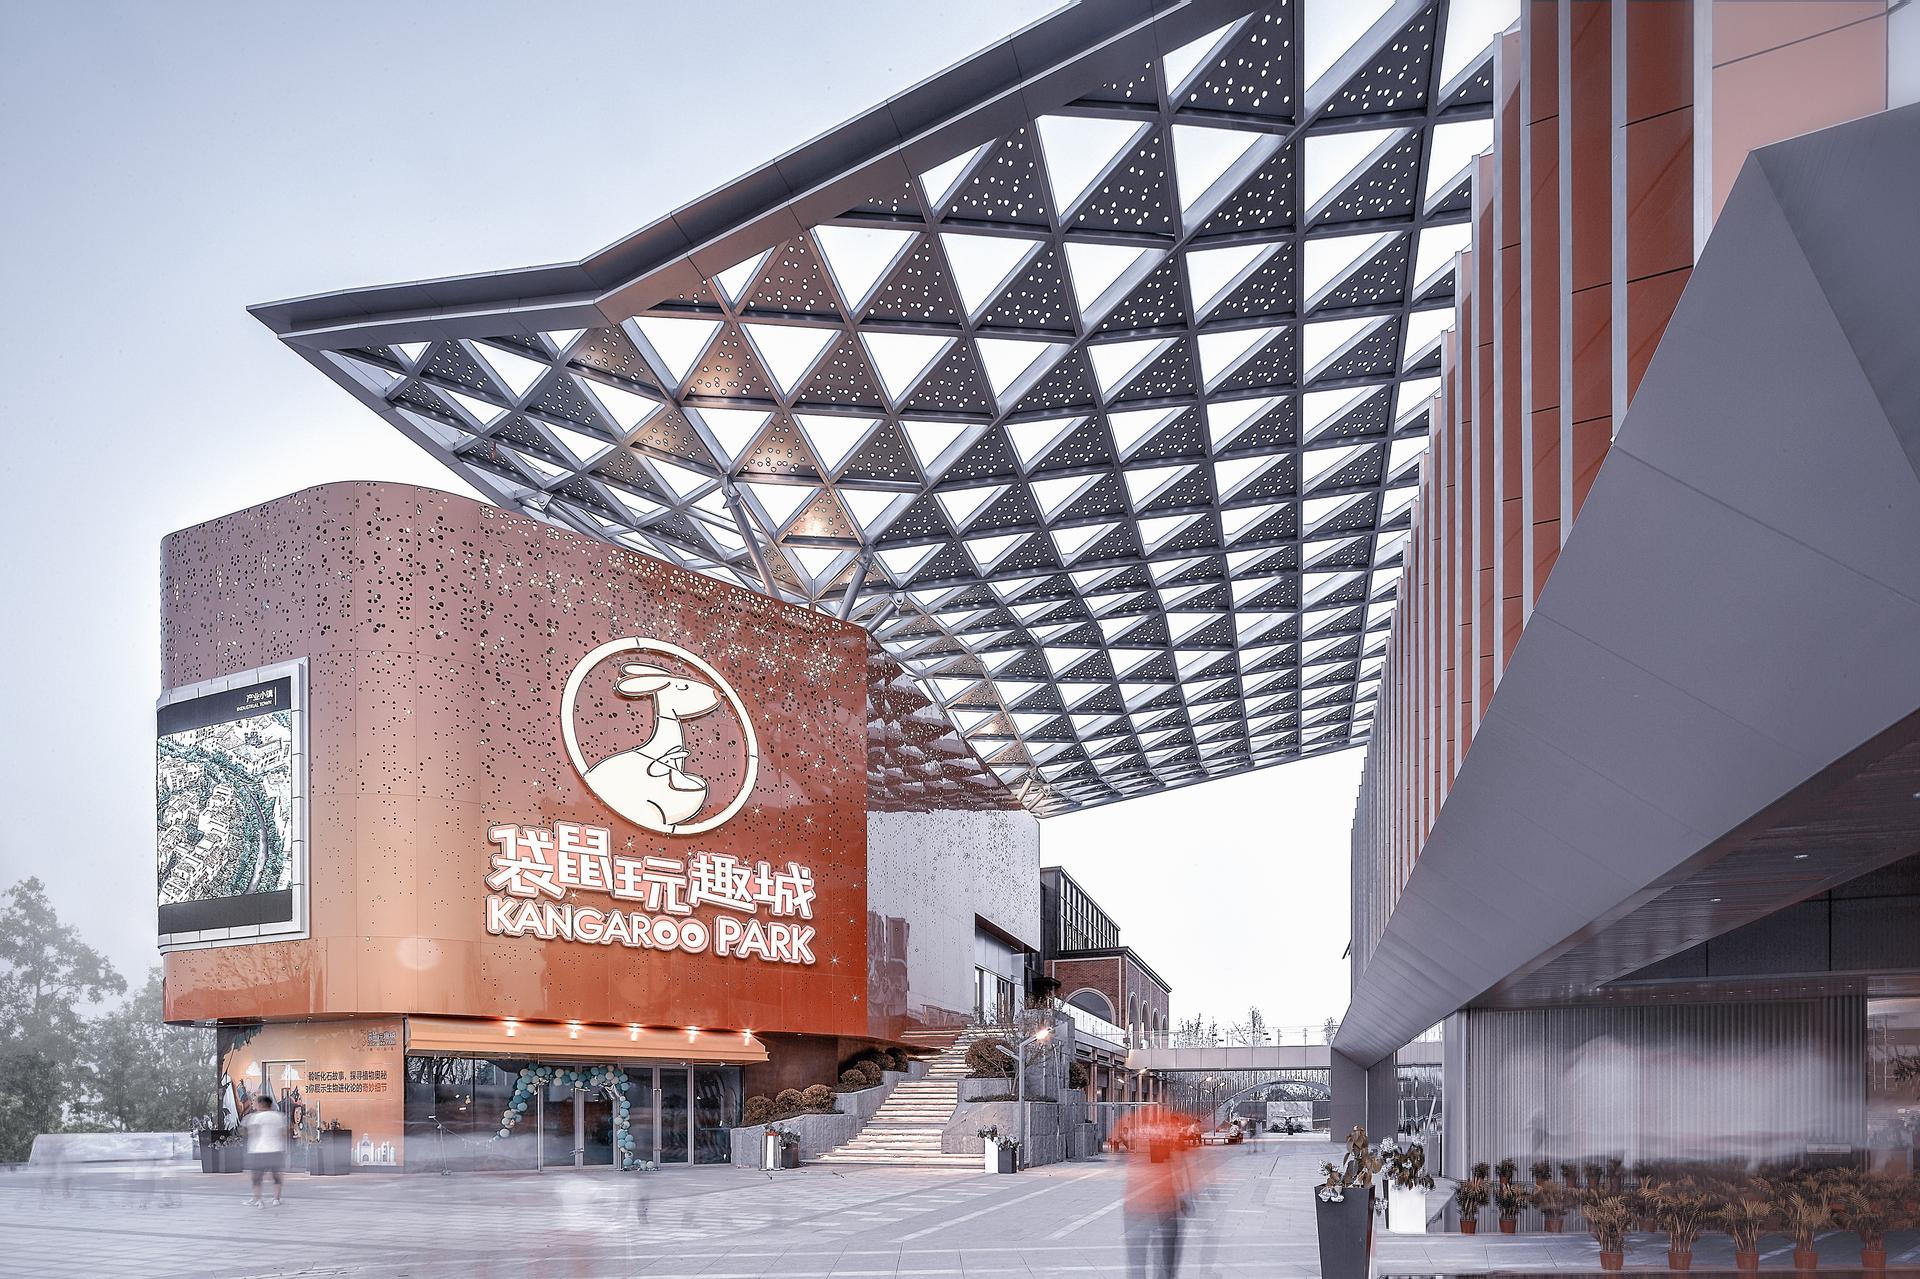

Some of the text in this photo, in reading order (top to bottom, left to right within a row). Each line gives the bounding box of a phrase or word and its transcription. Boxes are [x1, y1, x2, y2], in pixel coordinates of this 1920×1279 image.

[487, 822, 816, 919] 袋鼠玩趣城
[487, 896, 816, 964] KANGAROO PARK
